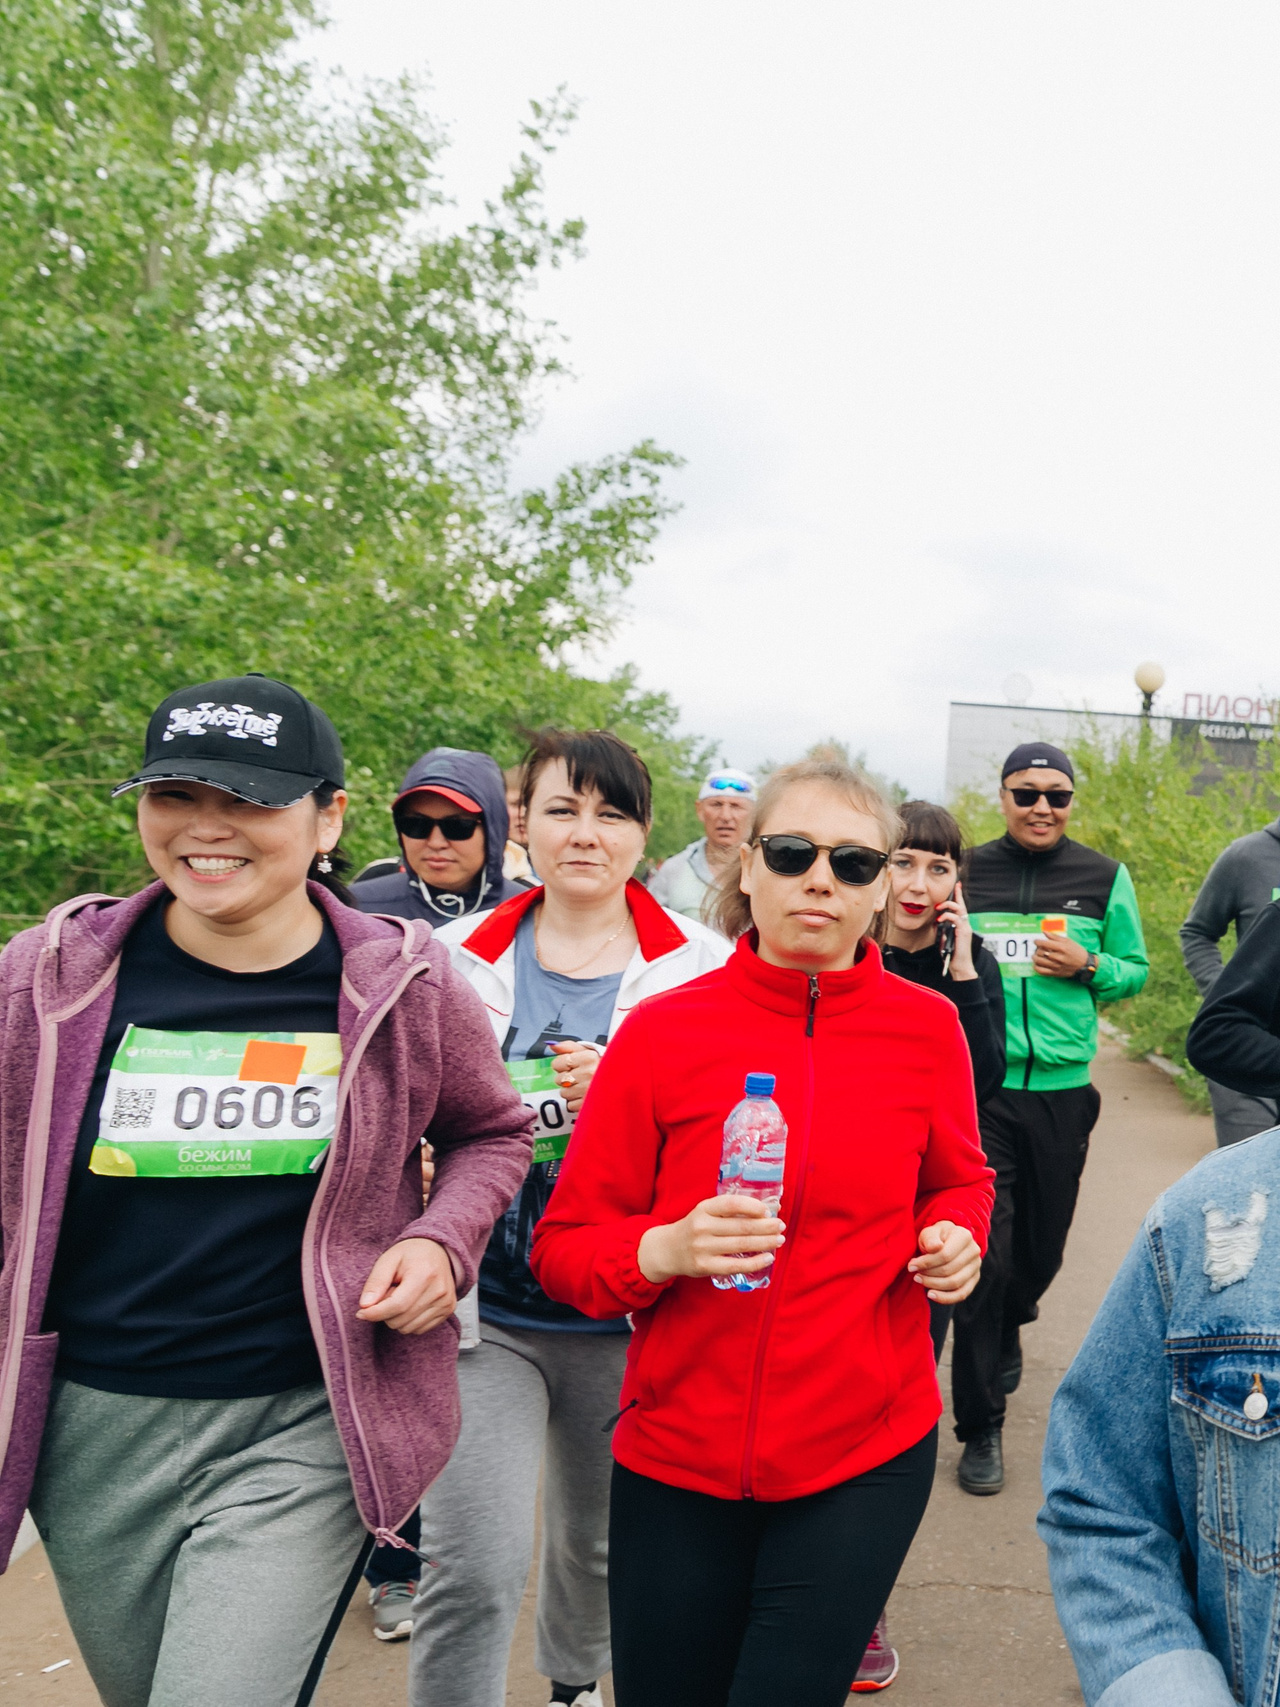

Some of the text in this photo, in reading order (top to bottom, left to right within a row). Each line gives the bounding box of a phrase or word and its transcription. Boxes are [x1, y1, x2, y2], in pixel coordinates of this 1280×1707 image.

[1006, 939, 1029, 957] 01
[173, 1085, 322, 1130] 0606
[178, 1146, 252, 1163] бежим
